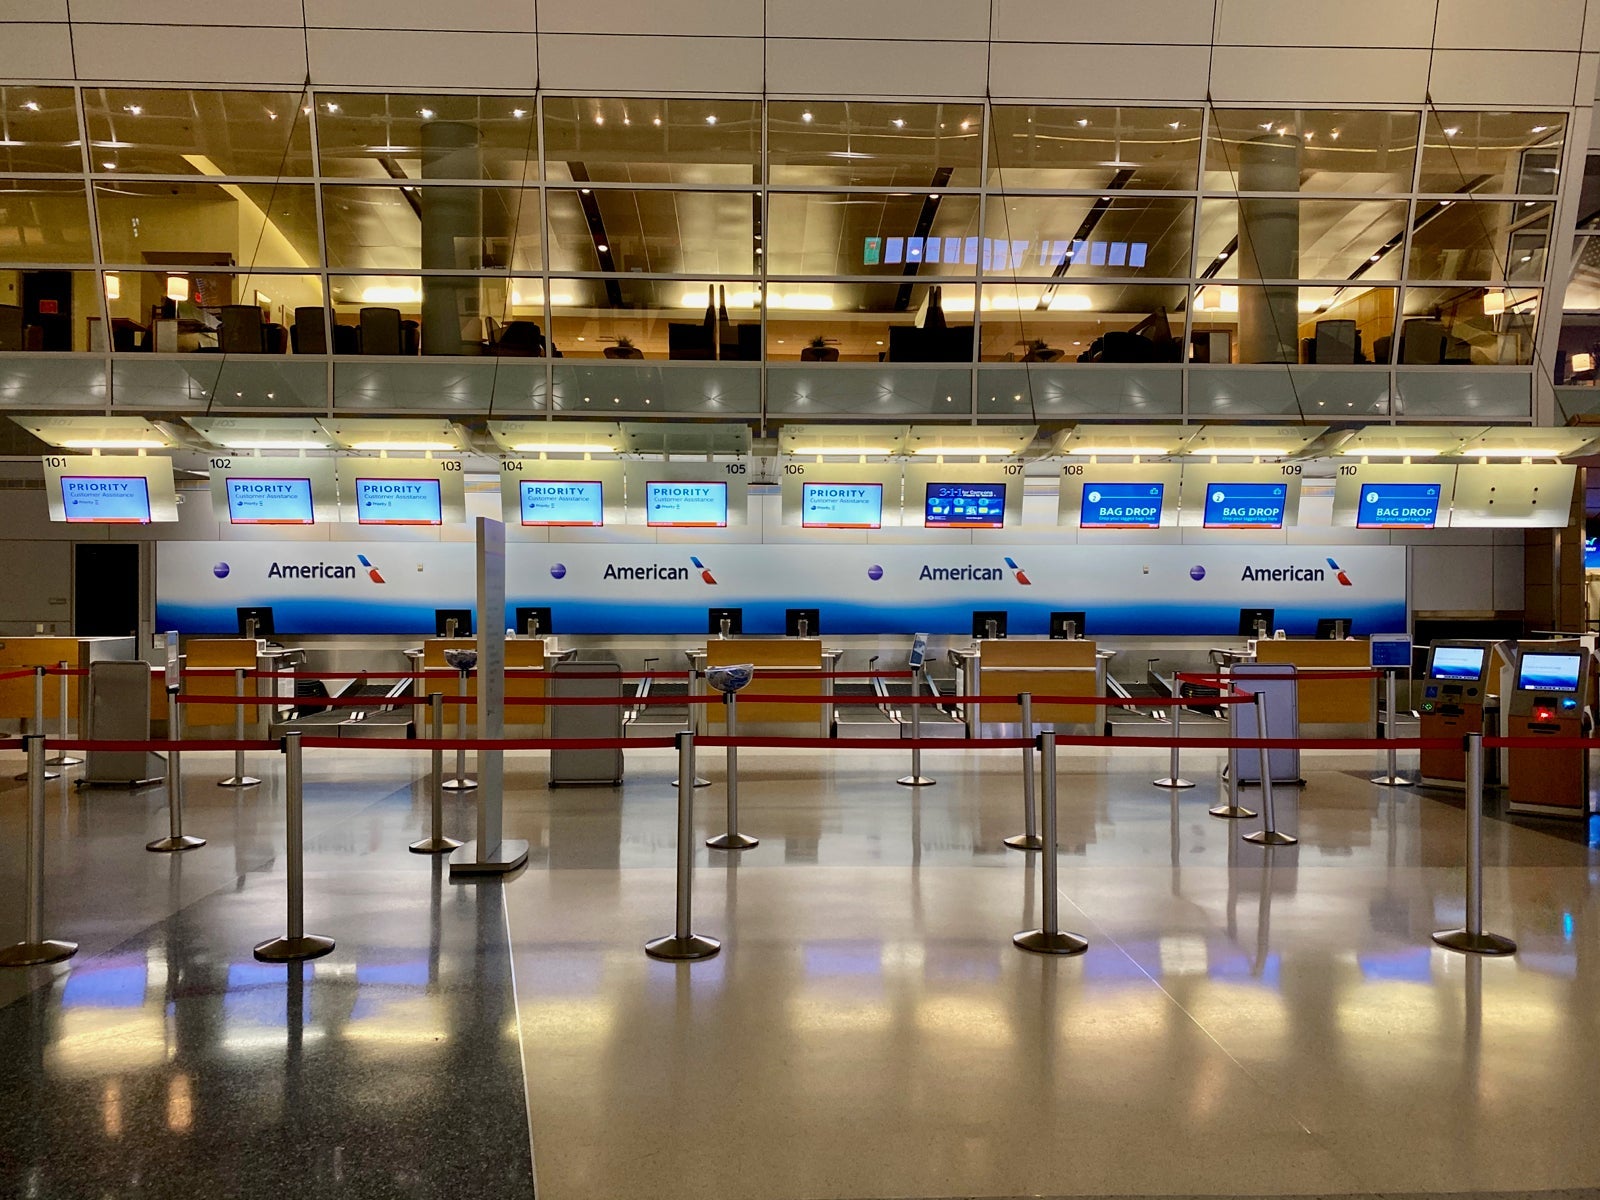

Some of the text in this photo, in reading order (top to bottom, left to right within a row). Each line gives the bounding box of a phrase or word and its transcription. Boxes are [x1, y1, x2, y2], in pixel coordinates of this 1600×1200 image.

[45, 457, 67, 468] 101
[210, 458, 231, 469] 102
[440, 461, 461, 471] 103
[502, 461, 523, 471] 104
[725, 464, 746, 474] 105
[784, 464, 805, 474] 106
[1003, 465, 1024, 475] 107
[1063, 465, 1083, 475] 108
[1281, 465, 1302, 475] 109
[1340, 465, 1357, 475] 110
[69, 483, 128, 491] PRIORITY
[363, 485, 422, 493] PRIORITY
[527, 487, 585, 495] PRIORITY
[653, 488, 710, 496] PRIORITY
[810, 489, 866, 497] PRIORITY
[1099, 507, 1157, 516] BAG DROP
[1223, 507, 1280, 516] BAG DROP
[1376, 508, 1432, 516] BAG DROP
[267, 562, 356, 579] American
[603, 563, 689, 580] American
[919, 564, 1003, 580] American
[1241, 565, 1324, 581] American
